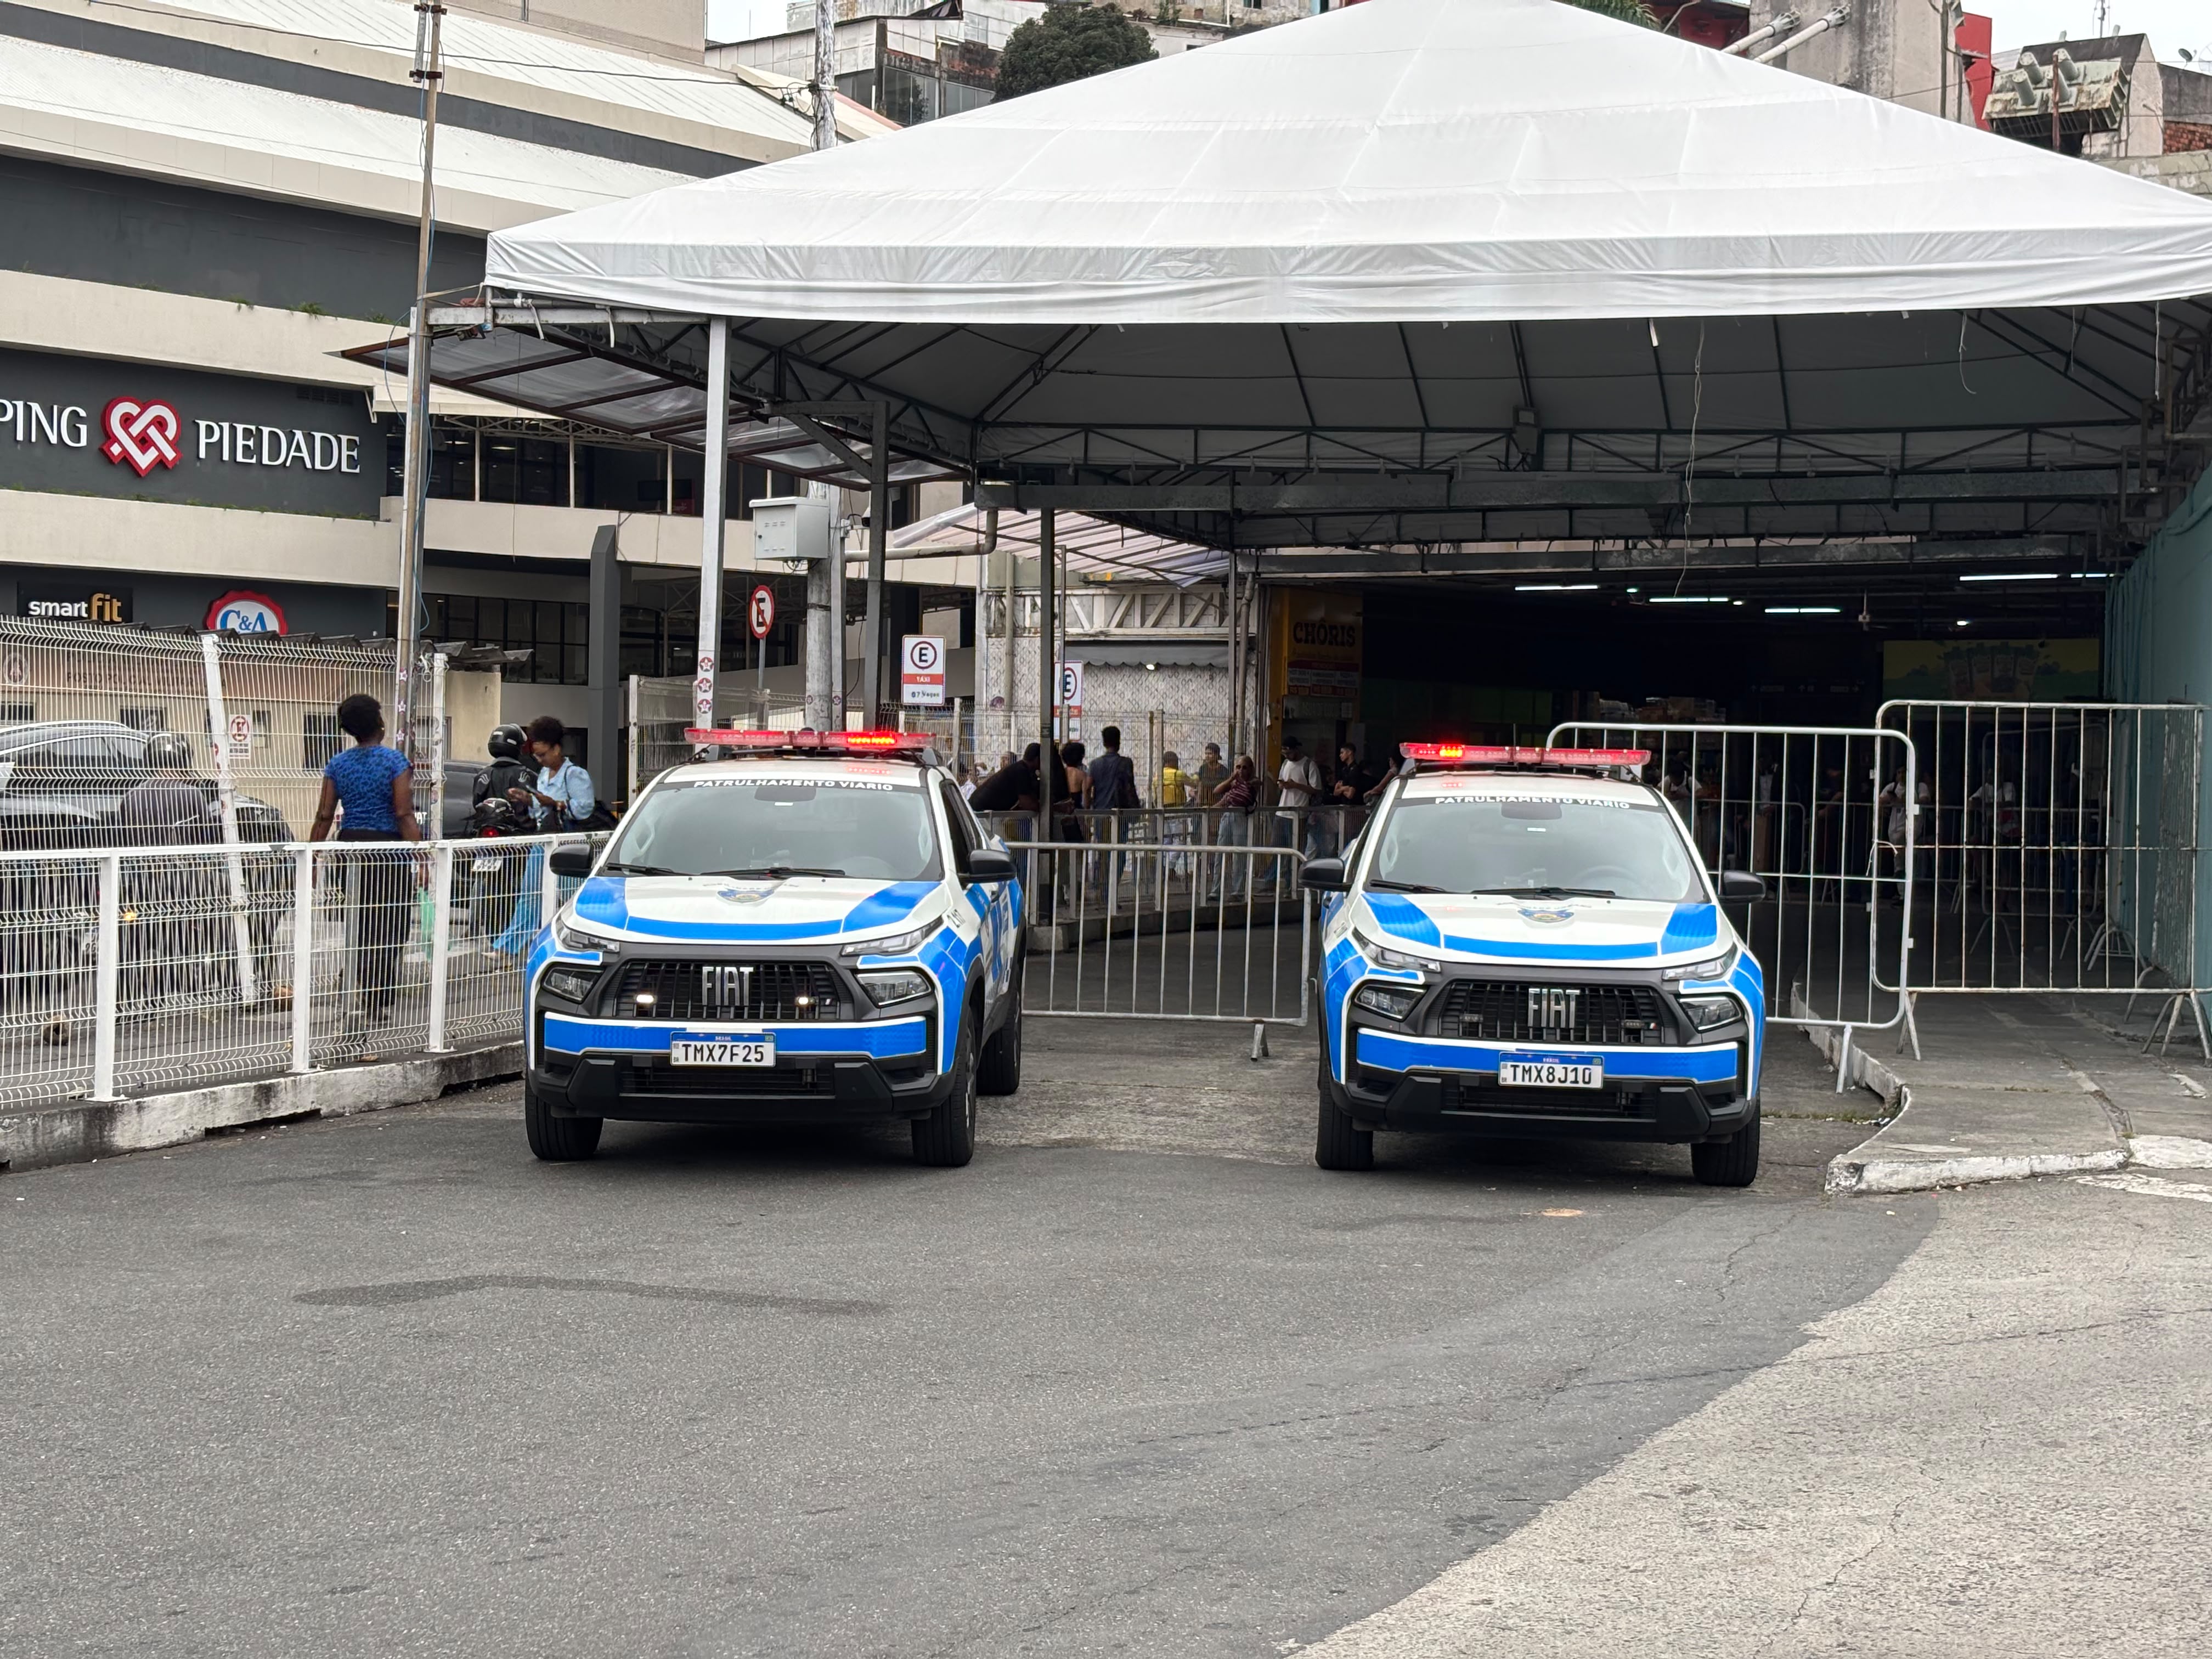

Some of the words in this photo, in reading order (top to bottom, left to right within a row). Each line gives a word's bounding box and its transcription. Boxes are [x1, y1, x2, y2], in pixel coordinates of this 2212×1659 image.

[195, 420, 360, 473] PIEDADE
[29, 601, 88, 618] smart
[92, 593, 122, 622] fit
[220, 609, 267, 632] C&A
[1293, 617, 1356, 647] CHÔRIS
[919, 647, 929, 663] E
[693, 780, 835, 788] PATRULHAMENTO
[1435, 796, 1573, 804] PATRULHAMENTO
[702, 966, 754, 1006] FIAT
[1527, 988, 1580, 1029] FIAT
[681, 1043, 765, 1063] TMX7F25
[1510, 1064, 1592, 1085] TMX8J10
